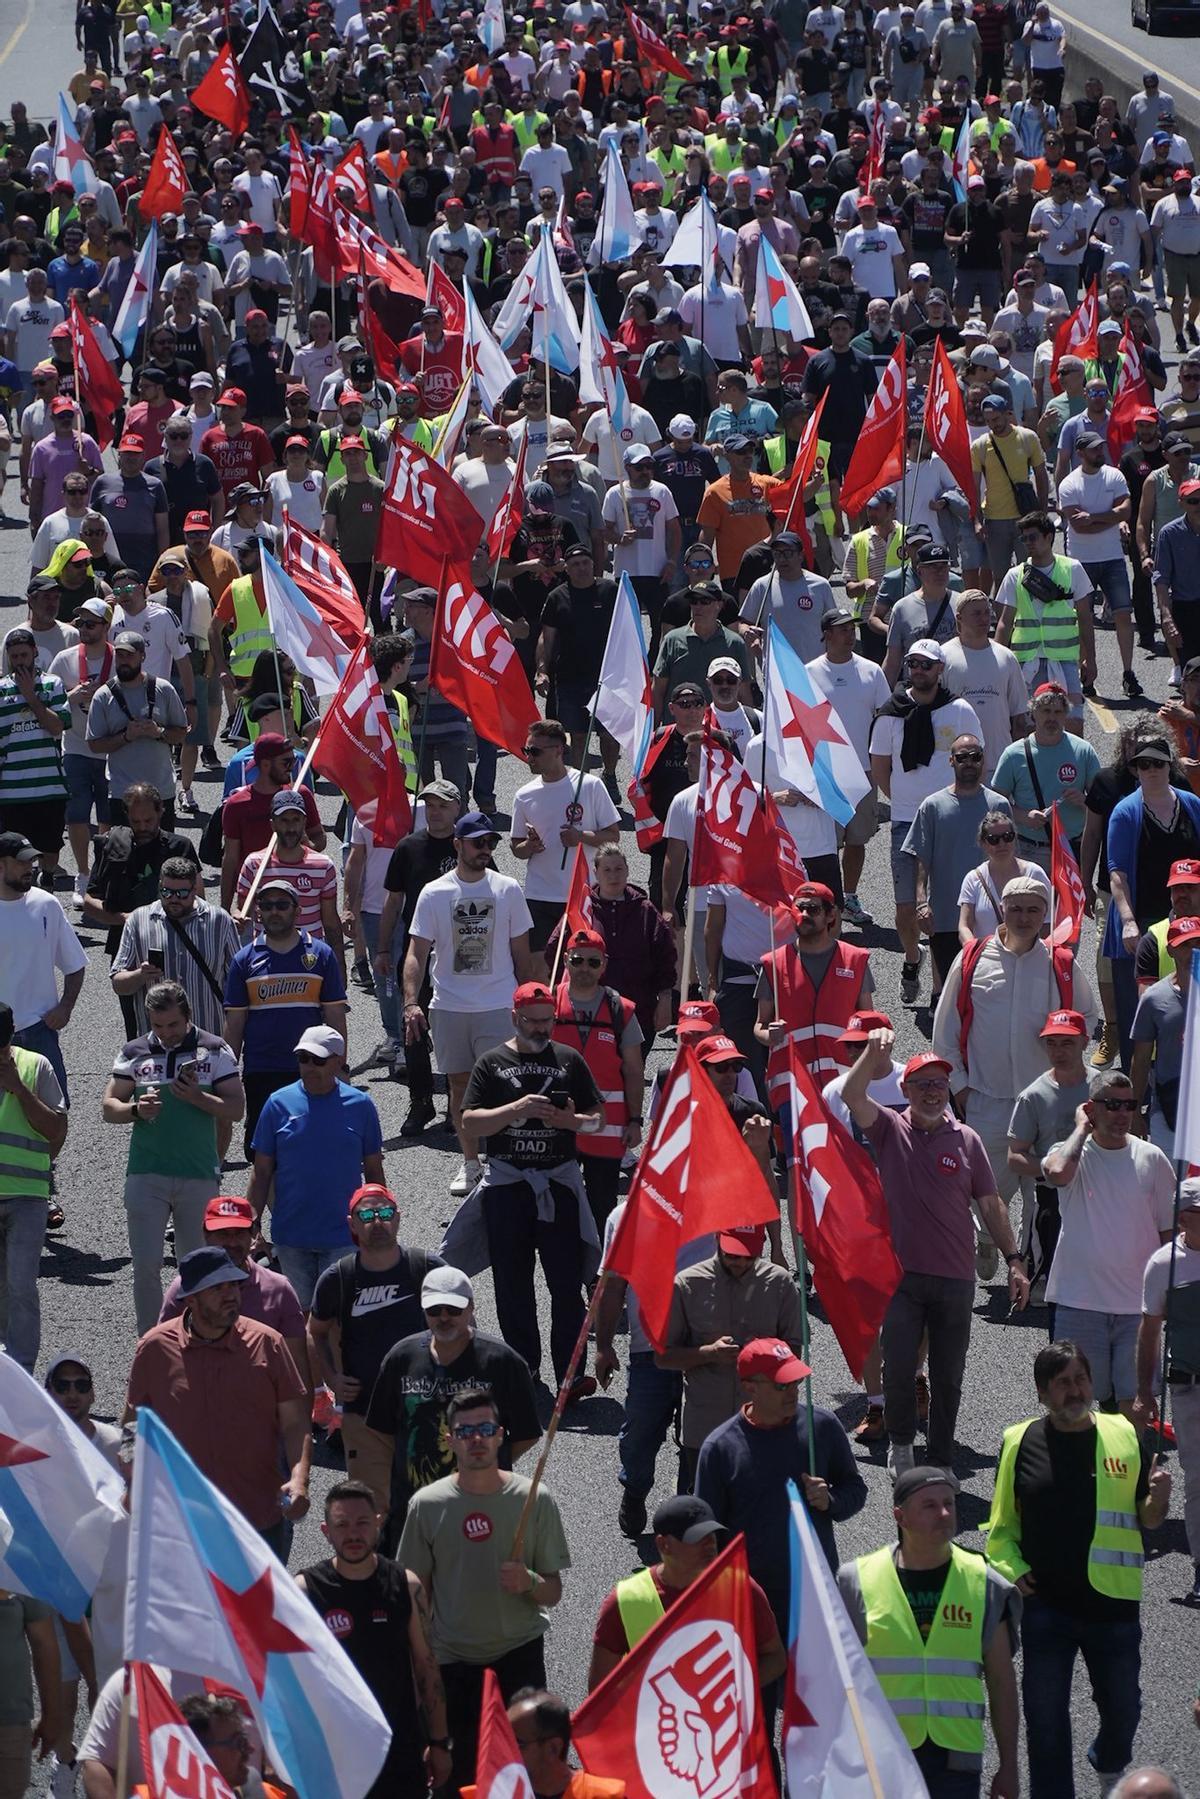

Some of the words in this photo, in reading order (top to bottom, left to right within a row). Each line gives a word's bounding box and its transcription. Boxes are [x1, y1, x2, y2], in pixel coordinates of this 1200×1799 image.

[11, 722, 40, 733] dafab
[459, 925, 488, 935] adidas
[503, 1066, 538, 1078] GUITAR
[541, 1066, 560, 1077] DAD
[515, 1140, 547, 1153] DAD
[357, 1285, 400, 1305] NIKE
[401, 1376, 431, 1394] Bob
[1103, 1457, 1128, 1473] CIG
[466, 1518, 489, 1532] CIG
[942, 1604, 972, 1622] CIG
[327, 1614, 349, 1629] CIG
[674, 1630, 743, 1770] UGT
[163, 1735, 238, 1799] UG
